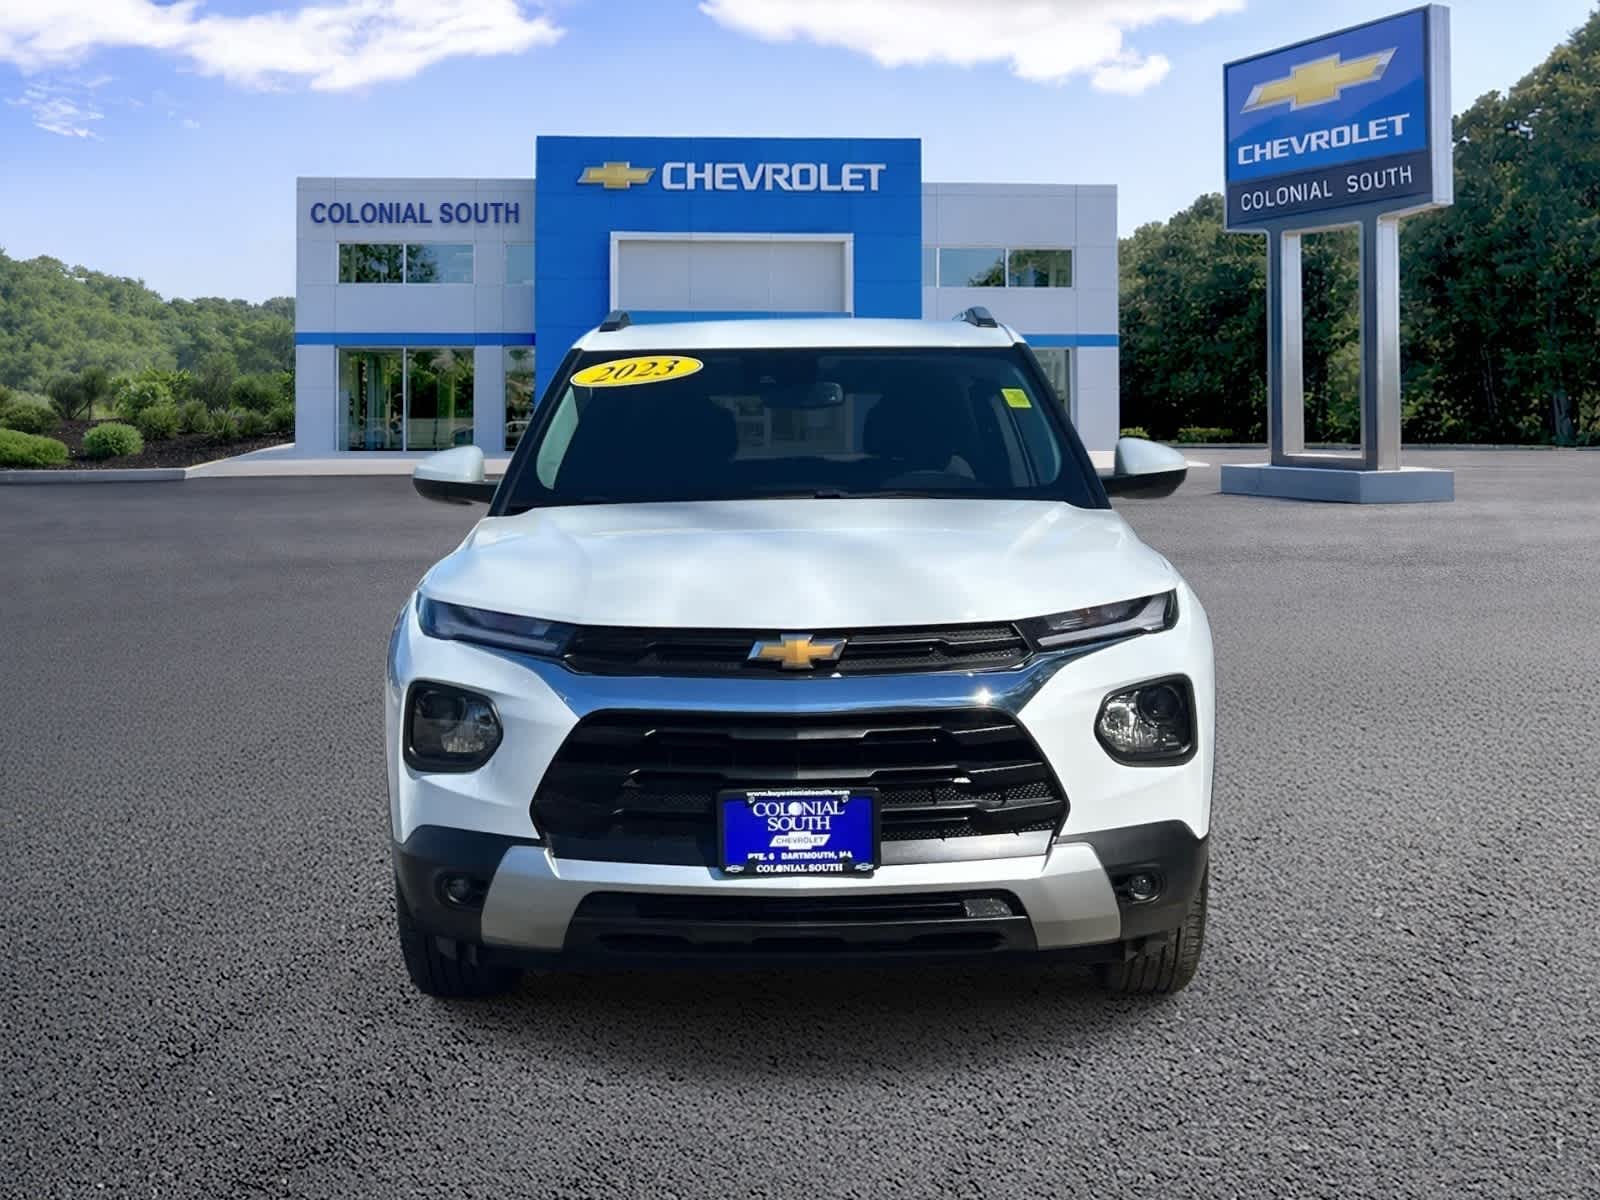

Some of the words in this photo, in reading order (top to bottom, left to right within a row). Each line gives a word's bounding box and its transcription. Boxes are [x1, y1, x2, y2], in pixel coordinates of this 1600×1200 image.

[1237, 113, 1410, 165] CHEVROLET
[661, 162, 887, 192] CHEVROLET
[1240, 180, 1333, 211] COLONIAL
[1346, 165, 1413, 193] SOUTH
[310, 202, 433, 224] COLONIAL
[439, 202, 520, 224] SOUTH
[589, 359, 681, 383] 2023
[753, 801, 845, 816] COLONIAL
[767, 816, 831, 831] SOUTH
[776, 837, 824, 845] CHEVROLET
[781, 851, 838, 860] DARTMOUTH,
[756, 864, 807, 873] COLONIAL
[808, 863, 843, 872] SOUTH
